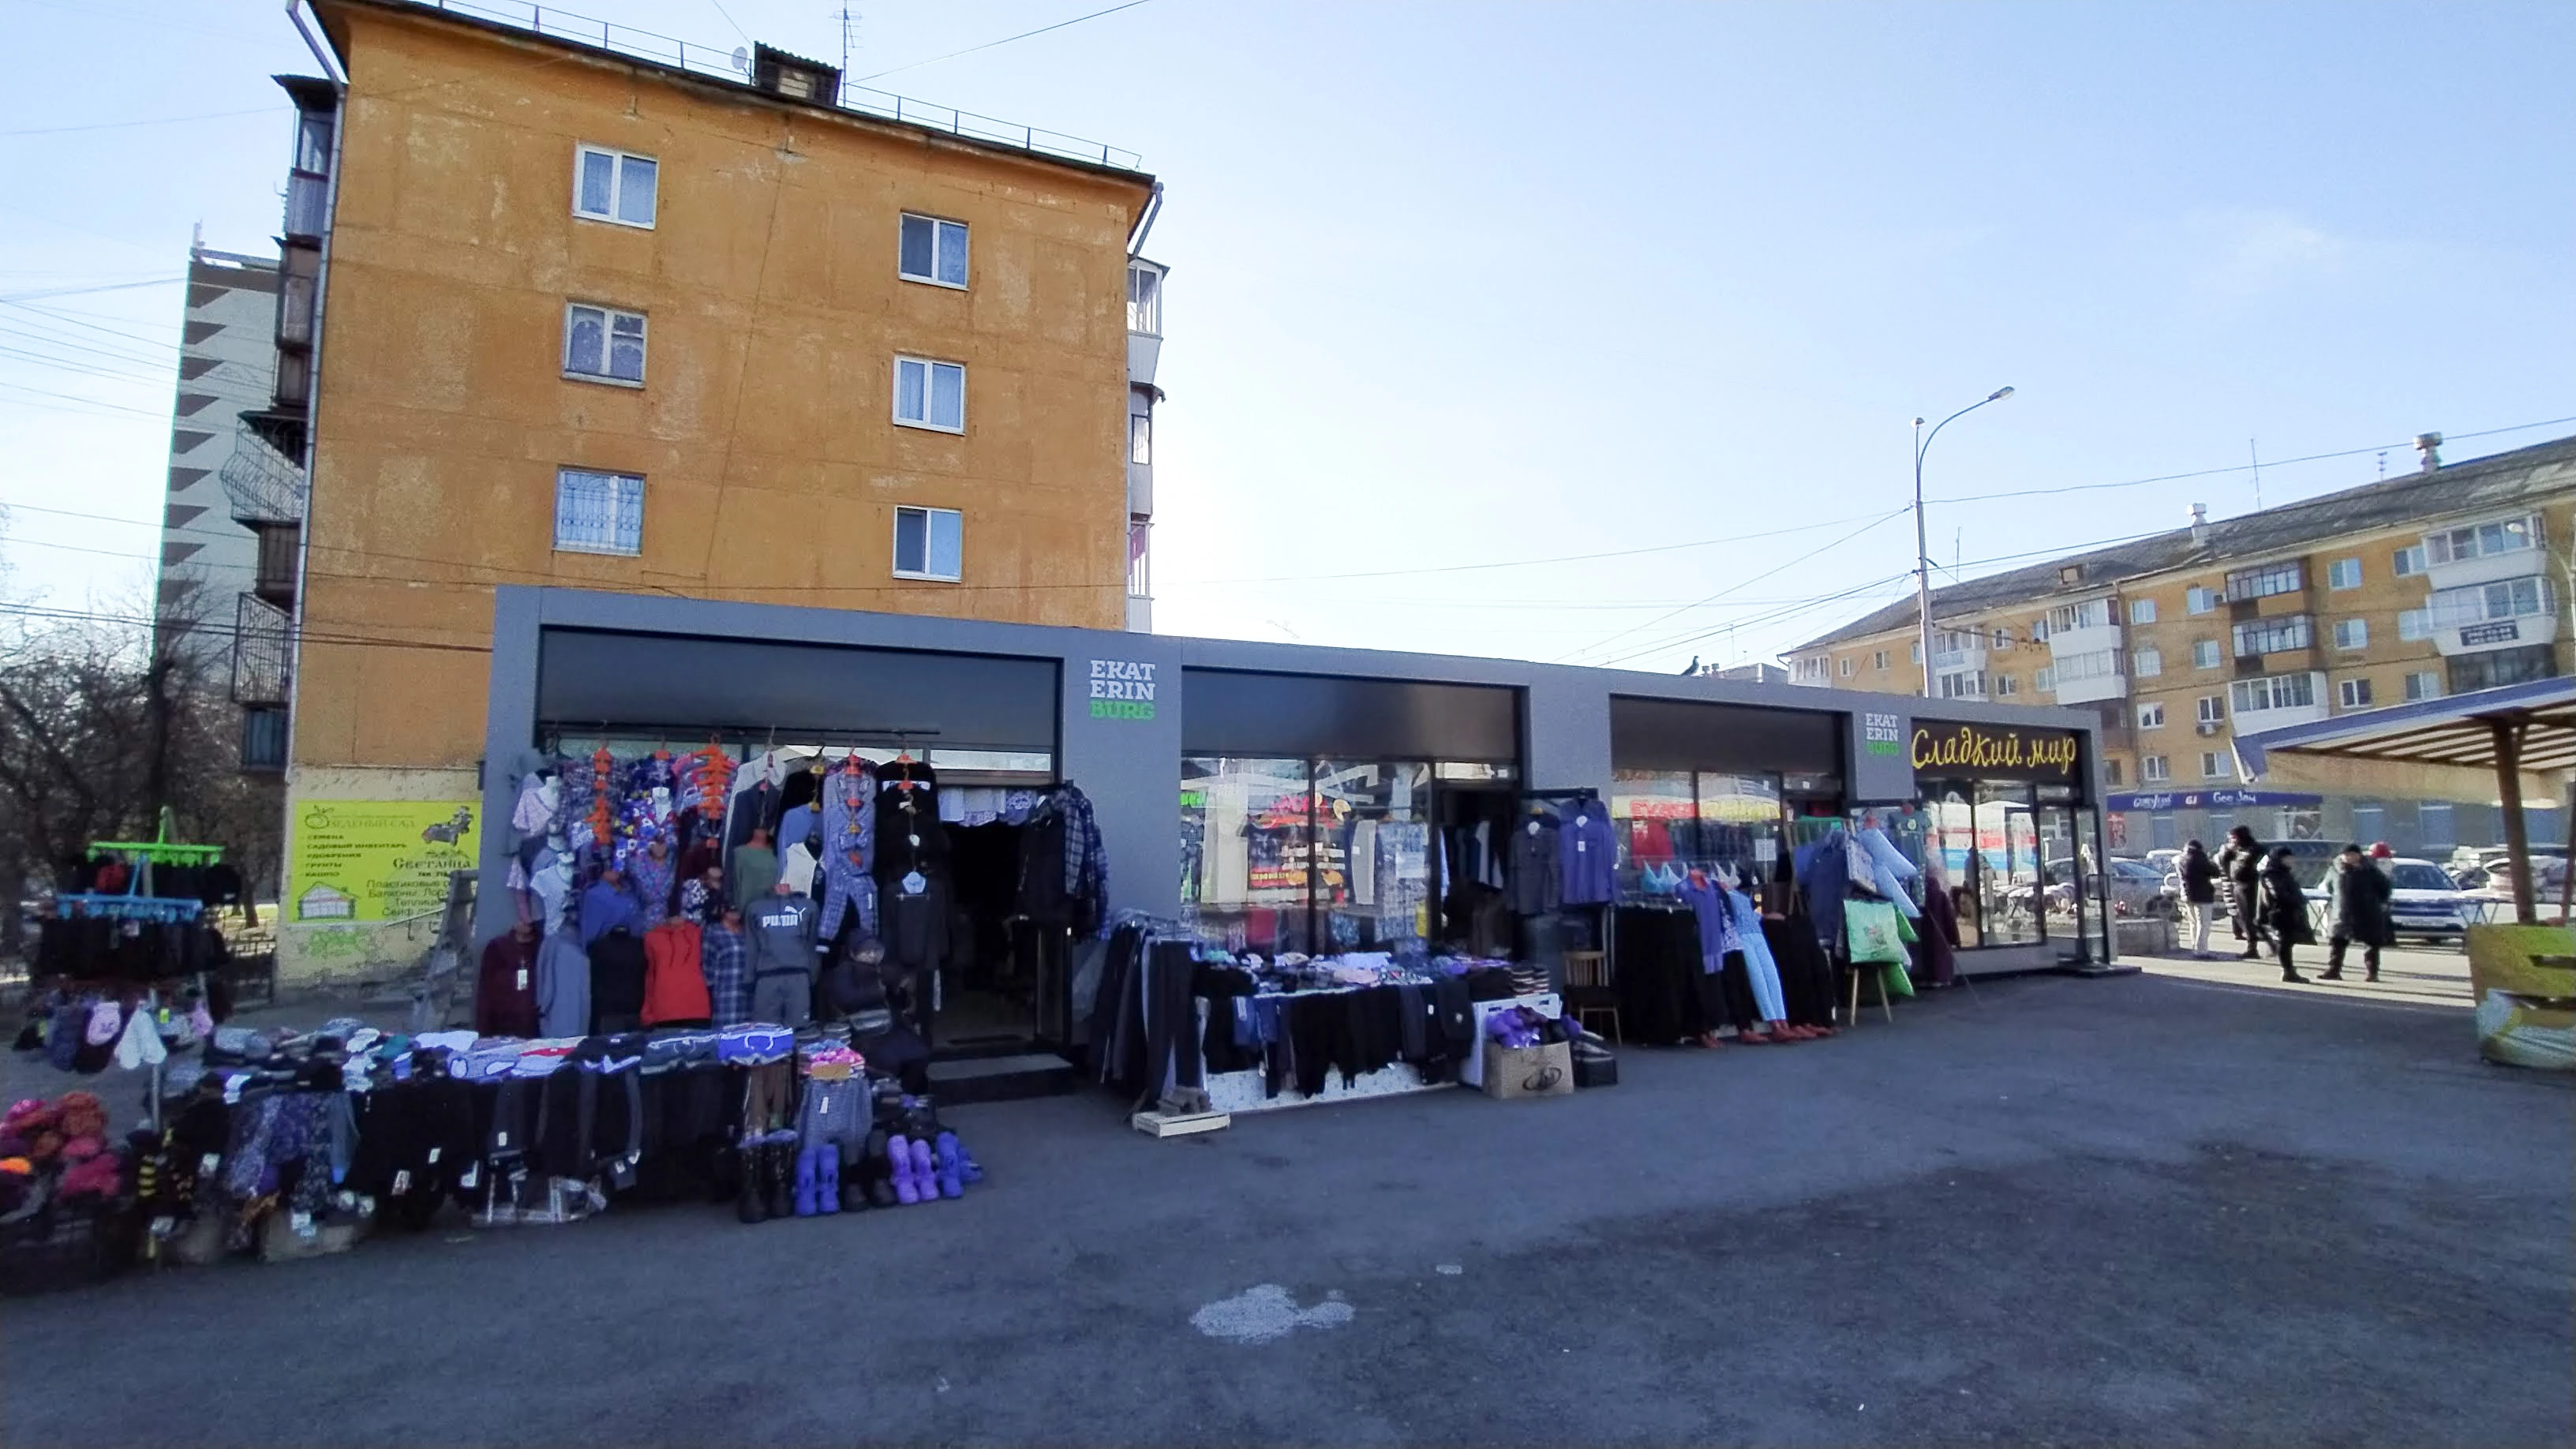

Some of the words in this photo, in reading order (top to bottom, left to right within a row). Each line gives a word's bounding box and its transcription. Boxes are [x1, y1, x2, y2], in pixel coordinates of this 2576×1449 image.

[1090, 660, 1155, 680] EKAT
[1090, 680, 1155, 700] ERIN
[1090, 700, 1155, 720] BURG
[1866, 713, 1898, 728] EKAT
[1866, 727, 1899, 742] ERIN
[1911, 727, 2022, 769] Сладкий
[2027, 736, 2076, 775] мир
[762, 915, 798, 927] PUMA
